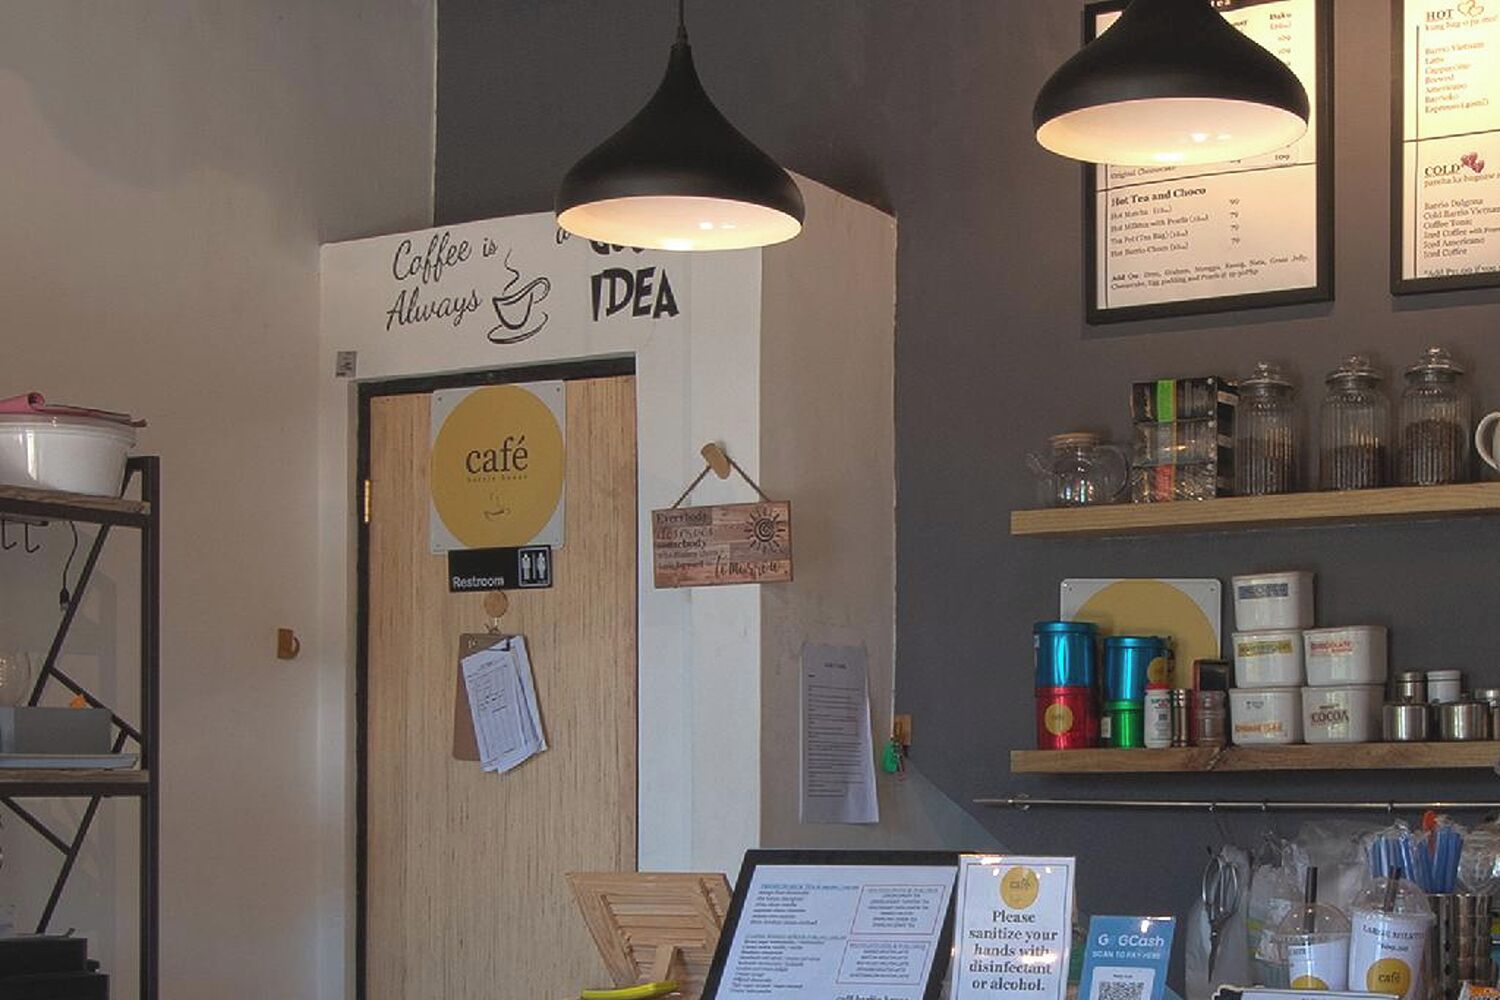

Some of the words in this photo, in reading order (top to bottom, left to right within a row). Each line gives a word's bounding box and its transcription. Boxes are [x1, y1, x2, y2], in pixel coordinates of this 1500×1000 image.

[1426, 9, 1454, 23] HOT
[1425, 163, 1461, 178] COLD
[1111, 197, 1129, 208] Hot
[1132, 193, 1150, 205] Tea
[1152, 189, 1171, 200] and
[1173, 186, 1207, 199] Choco
[1423, 211, 1443, 221] Cold
[1423, 222, 1450, 232] Coffee
[1443, 228, 1468, 239] Coffee
[1443, 237, 1485, 248] Americano
[393, 231, 472, 284] Coffee
[482, 237, 498, 257] is
[1443, 247, 1468, 257] Coffee
[591, 267, 680, 322] IDEA
[386, 287, 483, 331] Always
[466, 435, 528, 474] café
[453, 576, 505, 589] Restroom
[1311, 710, 1350, 723] COCOA
[992, 910, 1037, 924] Please
[968, 927, 1023, 941] sanitize
[1025, 930, 1059, 944] your
[1118, 934, 1165, 947] GCash
[974, 943, 1016, 957] hands
[1092, 950, 1114, 958] SCAN
[1116, 950, 1126, 958] TO
[969, 961, 1053, 975] disinfectant
[1378, 971, 1402, 983] café
[971, 980, 989, 991] or
[990, 977, 1046, 992] alcohol.
